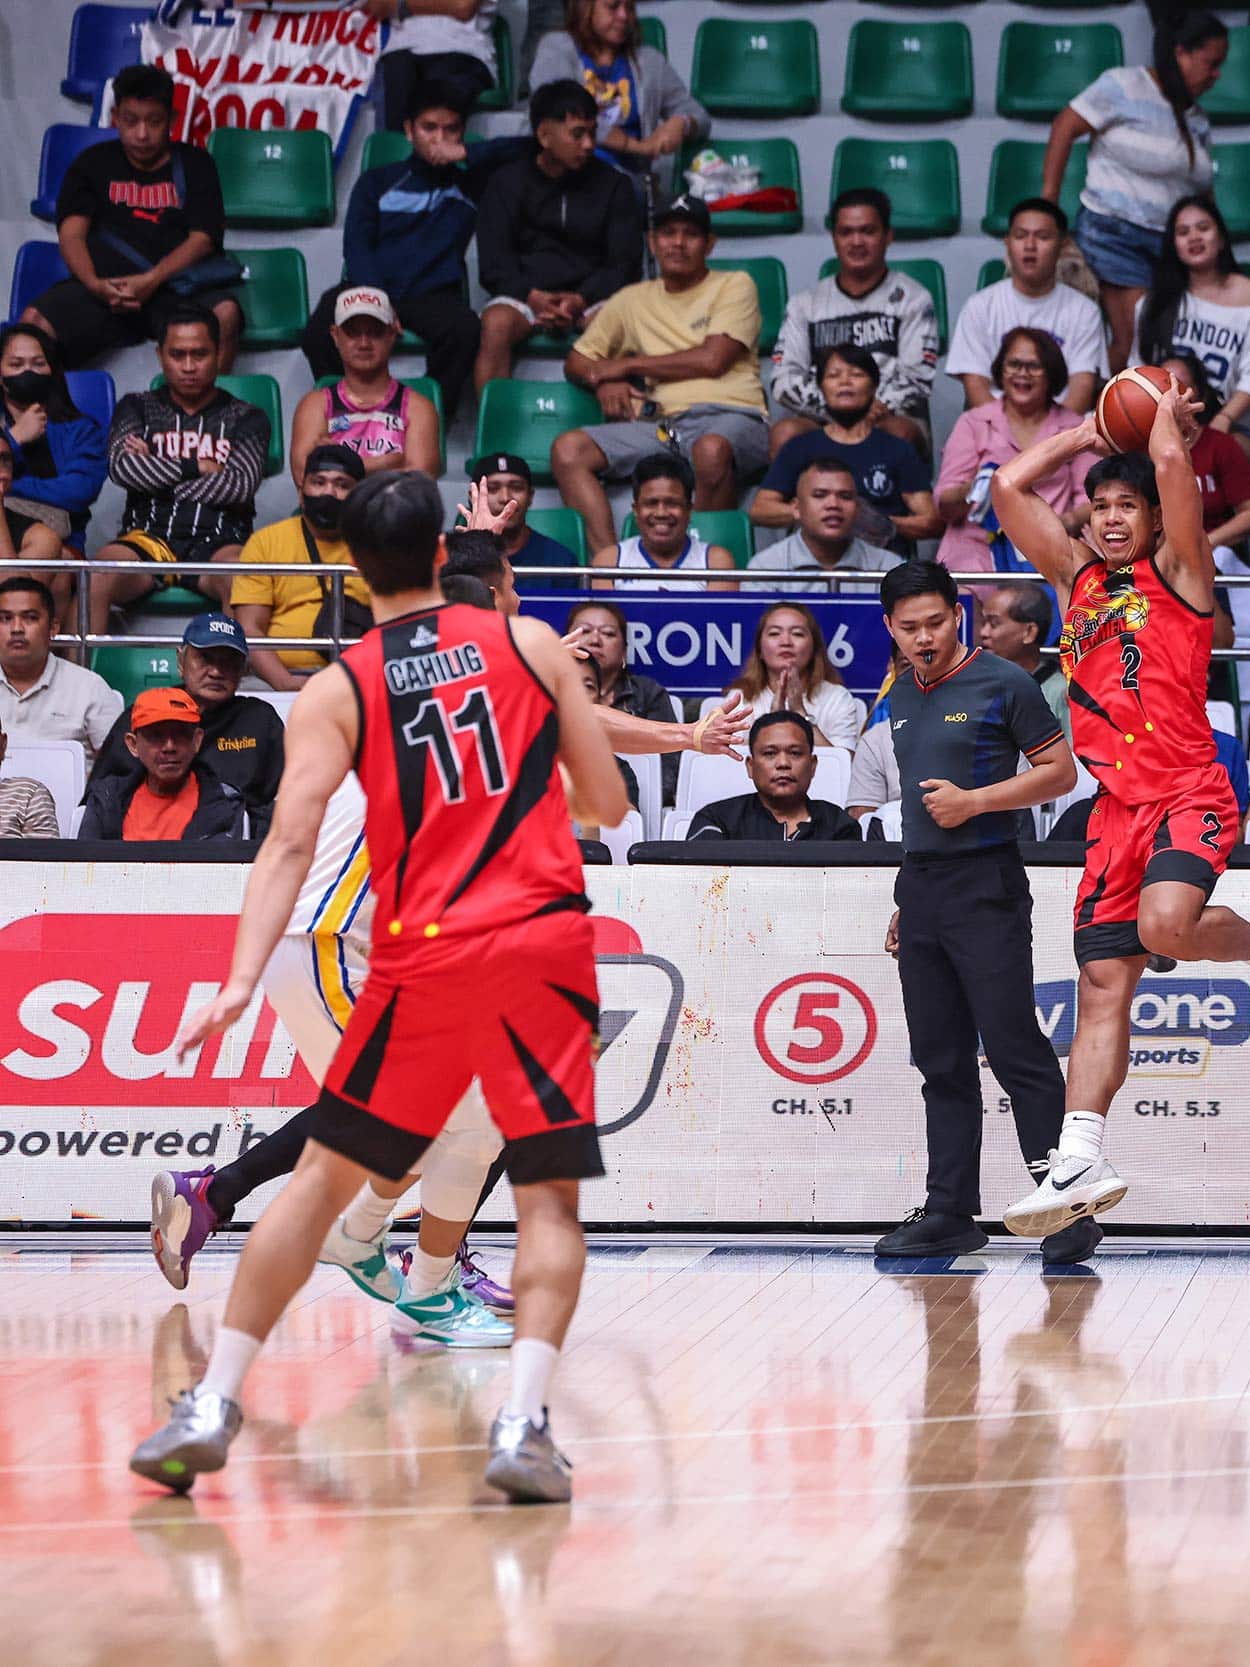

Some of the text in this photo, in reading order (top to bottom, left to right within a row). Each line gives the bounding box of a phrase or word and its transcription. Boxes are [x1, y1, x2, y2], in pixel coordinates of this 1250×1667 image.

[264, 144, 282, 159] 12
[342, 293, 382, 307] NASA
[1175, 318, 1244, 355] ONDON
[209, 621, 236, 636] SPORT
[150, 659, 169, 673] 12
[384, 641, 488, 696] CAHILIG
[1120, 644, 1143, 690] 2
[402, 685, 511, 806] 11
[1199, 811, 1223, 853] 2
[1130, 992, 1238, 1031] one
[786, 992, 844, 1064] 5
[1129, 1047, 1200, 1066] sports
[771, 1098, 853, 1115] CH. 5.1
[1134, 1100, 1221, 1118] CH. 5.3
[238, 1123, 269, 1155] b
